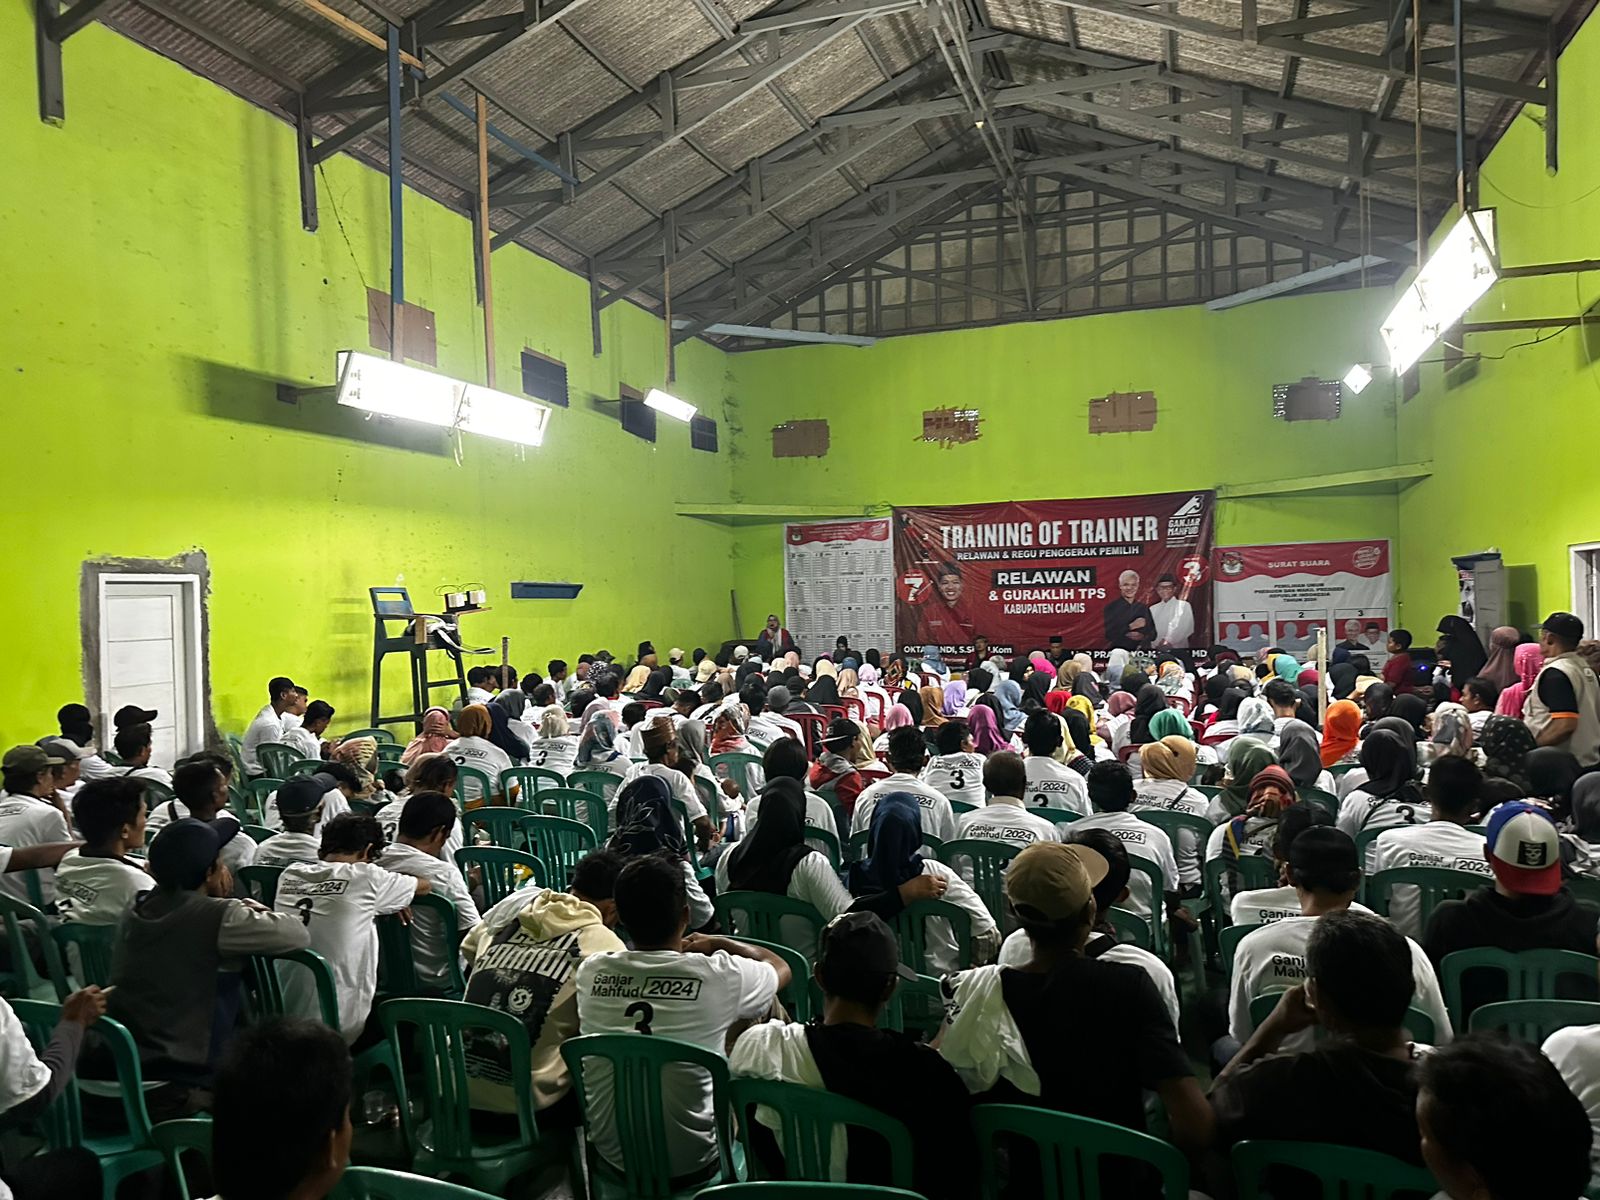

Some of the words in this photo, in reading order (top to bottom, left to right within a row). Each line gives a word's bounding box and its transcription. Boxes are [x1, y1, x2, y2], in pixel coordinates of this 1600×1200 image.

[1168, 518, 1201, 528] GANJAR
[940, 522, 1033, 549] TRAINING
[1039, 520, 1063, 546] OF
[1068, 516, 1158, 545] TRAINER
[1168, 526, 1199, 536] MAHFUD
[957, 551, 1000, 560] RELAWAN
[1002, 551, 1010, 559] &
[1012, 550, 1037, 559] REGU
[1039, 548, 1097, 558] PENGGERAK
[1099, 546, 1139, 555] PEMILIH
[1300, 559, 1330, 567] SUARA
[997, 570, 1091, 585] RELAWAN
[1183, 561, 1201, 582] 3
[904, 578, 923, 601] 7
[988, 591, 998, 600] &
[1003, 588, 1074, 600] GURAKLIH
[1078, 588, 1106, 599] TPS
[1003, 603, 1053, 614] KABUPATEN
[1055, 603, 1085, 613] CIAMIS
[537, 751, 547, 766] 3
[950, 769, 965, 789] 3
[1042, 782, 1066, 791] 2024
[970, 824, 996, 833] Ganjar
[970, 831, 1000, 839] Mahfud
[1005, 829, 1032, 840] 2024
[1115, 831, 1142, 841] 2024
[1409, 852, 1444, 863] Ganjar
[1458, 860, 1492, 873] 2024
[311, 881, 342, 893] 2024
[1272, 955, 1305, 968] Ganj
[1274, 966, 1306, 977] Mah
[593, 973, 634, 987] Ganjar
[591, 984, 640, 998] Mahfud
[648, 980, 694, 996] 2024
[624, 1001, 655, 1035] 3
